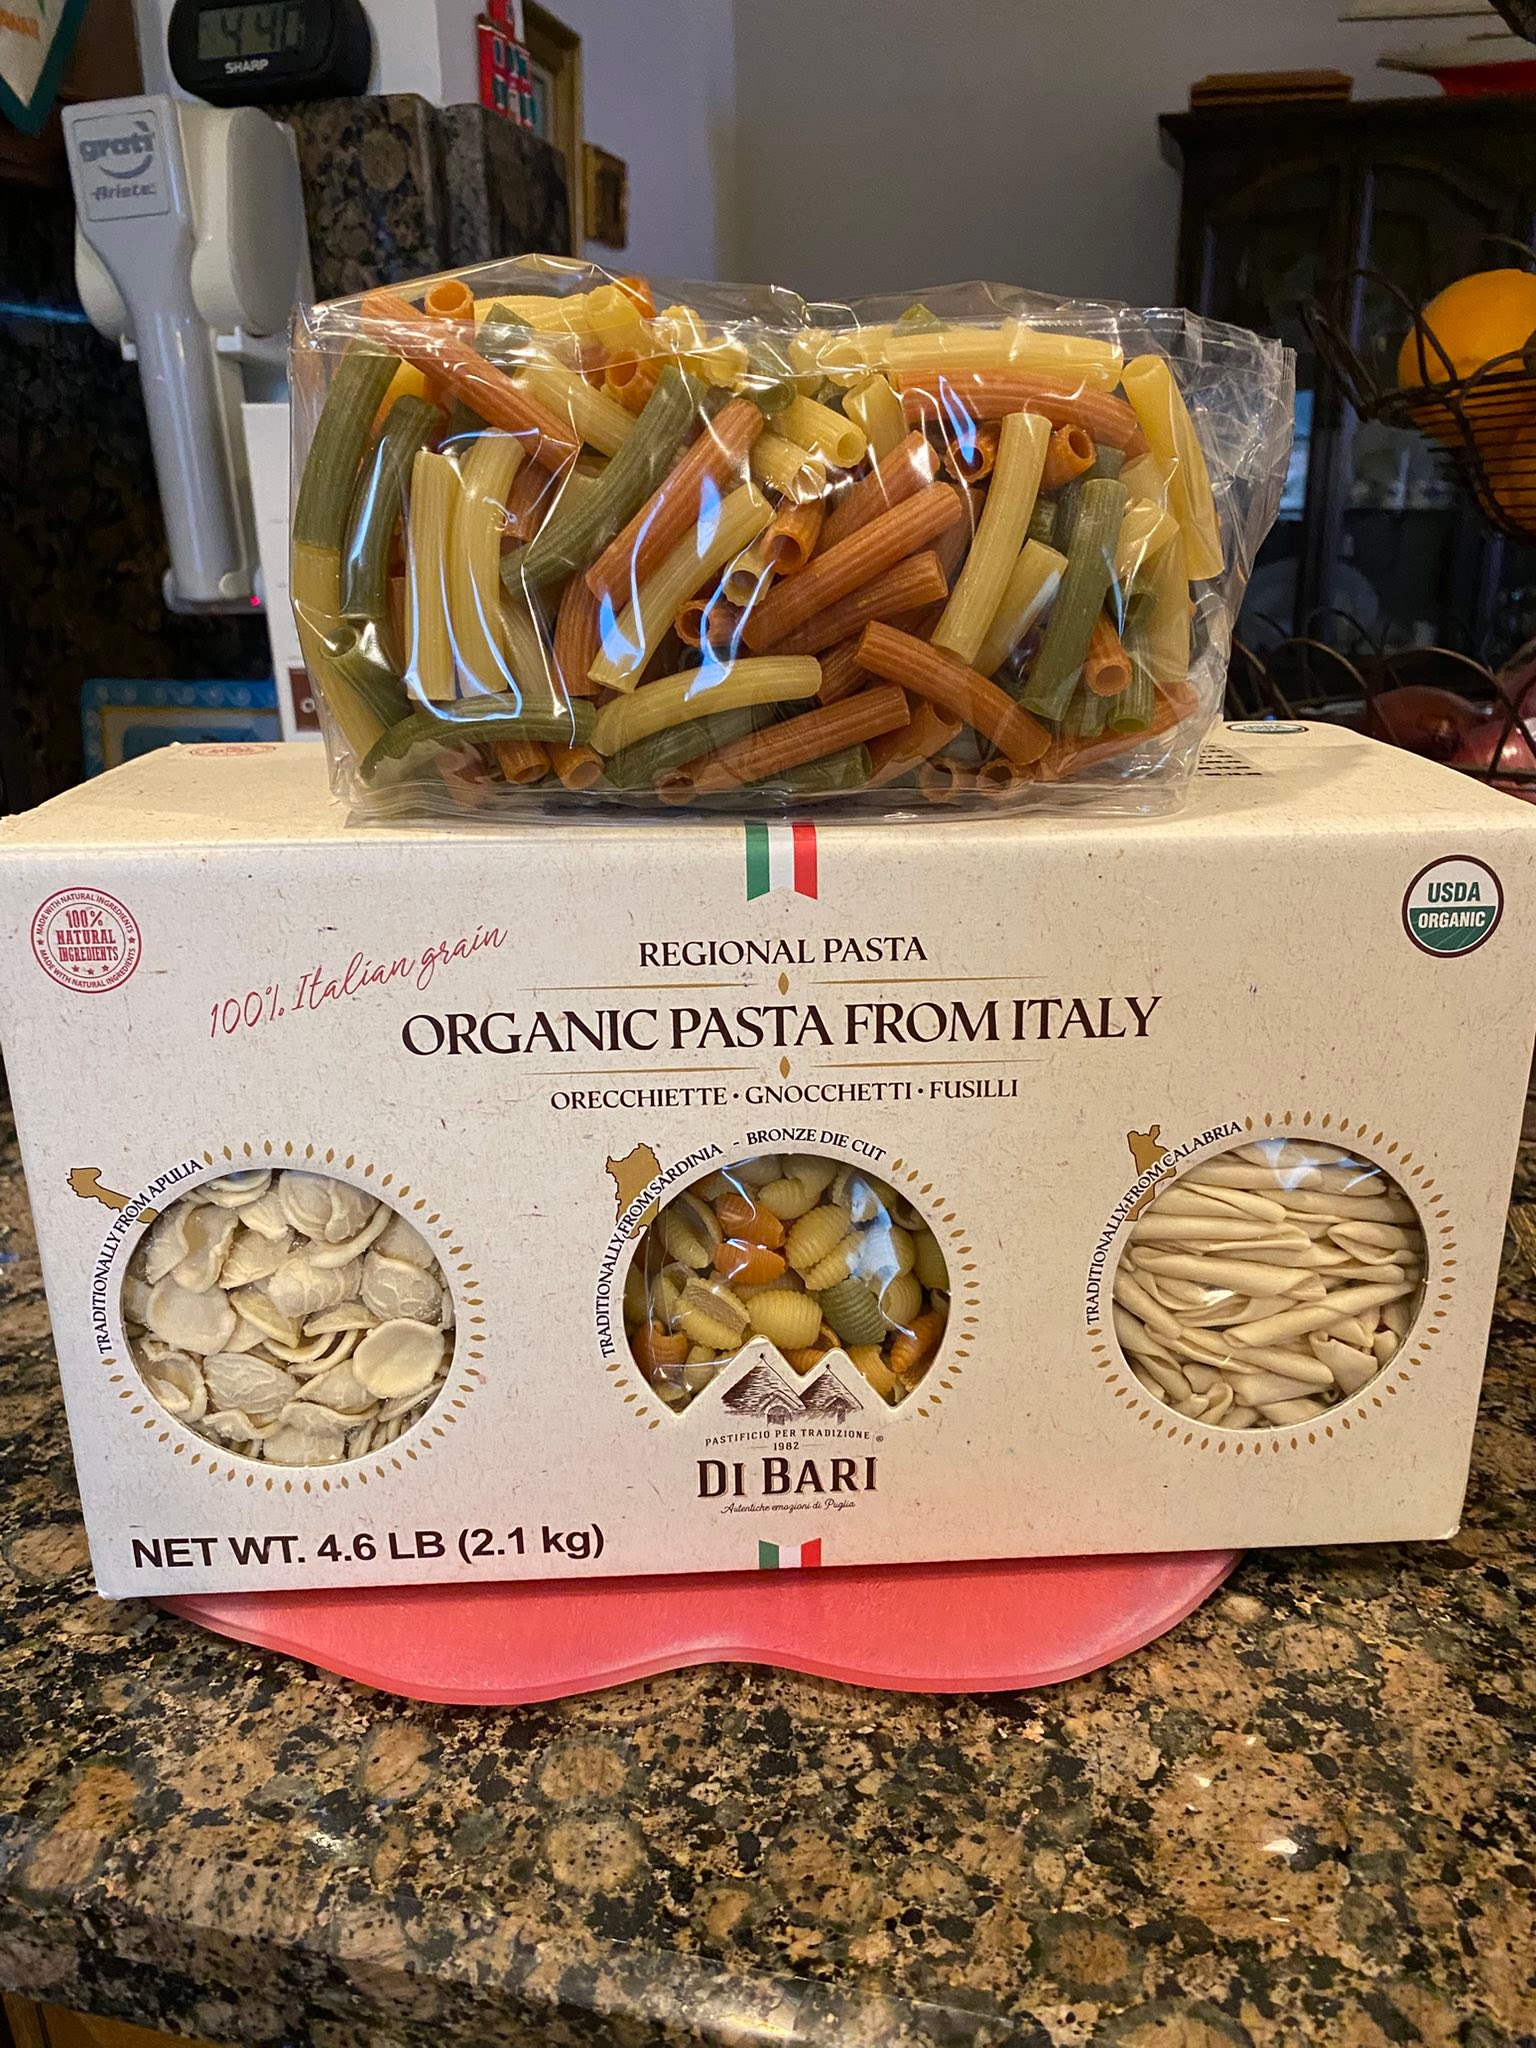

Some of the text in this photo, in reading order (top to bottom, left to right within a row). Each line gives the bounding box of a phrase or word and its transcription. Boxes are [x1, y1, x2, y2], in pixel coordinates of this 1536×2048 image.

[225, 58, 269, 75] SHARP
[1427, 881, 1481, 903] USDA
[36, 892, 134, 935] MADE WITH NATURAL INGREDIENTS
[65, 909, 104, 928] 100%
[1418, 911, 1487, 929] ORGANIC
[56, 929, 116, 945] NATURAL
[639, 936, 928, 967] REGIONAL PASTA
[40, 947, 136, 989] MADE WITH NATURAL INGREDIENTS
[57, 946, 119, 962] INGREDIENTS
[210, 924, 509, 1038] 100% Italian grain
[401, 995, 1163, 1056] ORGANIC PASTA FROM ITALY
[550, 1079, 1019, 1111] ORECCHIETTE GNOCCHETTI FUSILLI
[1086, 1121, 1243, 1326] TRADITIONALLY FROM CALABRIA
[92, 1159, 204, 1355] TRADITIONALLY FROM APULIA
[596, 1230, 626, 1358] TRADITIONALLY
[616, 1189, 655, 1237] FROM
[649, 1143, 724, 1195] SARDINIA
[746, 1127, 817, 1145] BRONZE
[820, 1130, 849, 1148] DIE
[851, 1139, 887, 1162] CUT
[705, 1428, 870, 1447] PASTIFICIO PER TRADIZIONE
[773, 1441, 800, 1451] 1982
[761, 1457, 878, 1495] BARI
[720, 1498, 856, 1514] Autentiche emozioni di Puglia
[131, 1523, 605, 1568] NET WT. 4.6 LB (2.1 kg)
